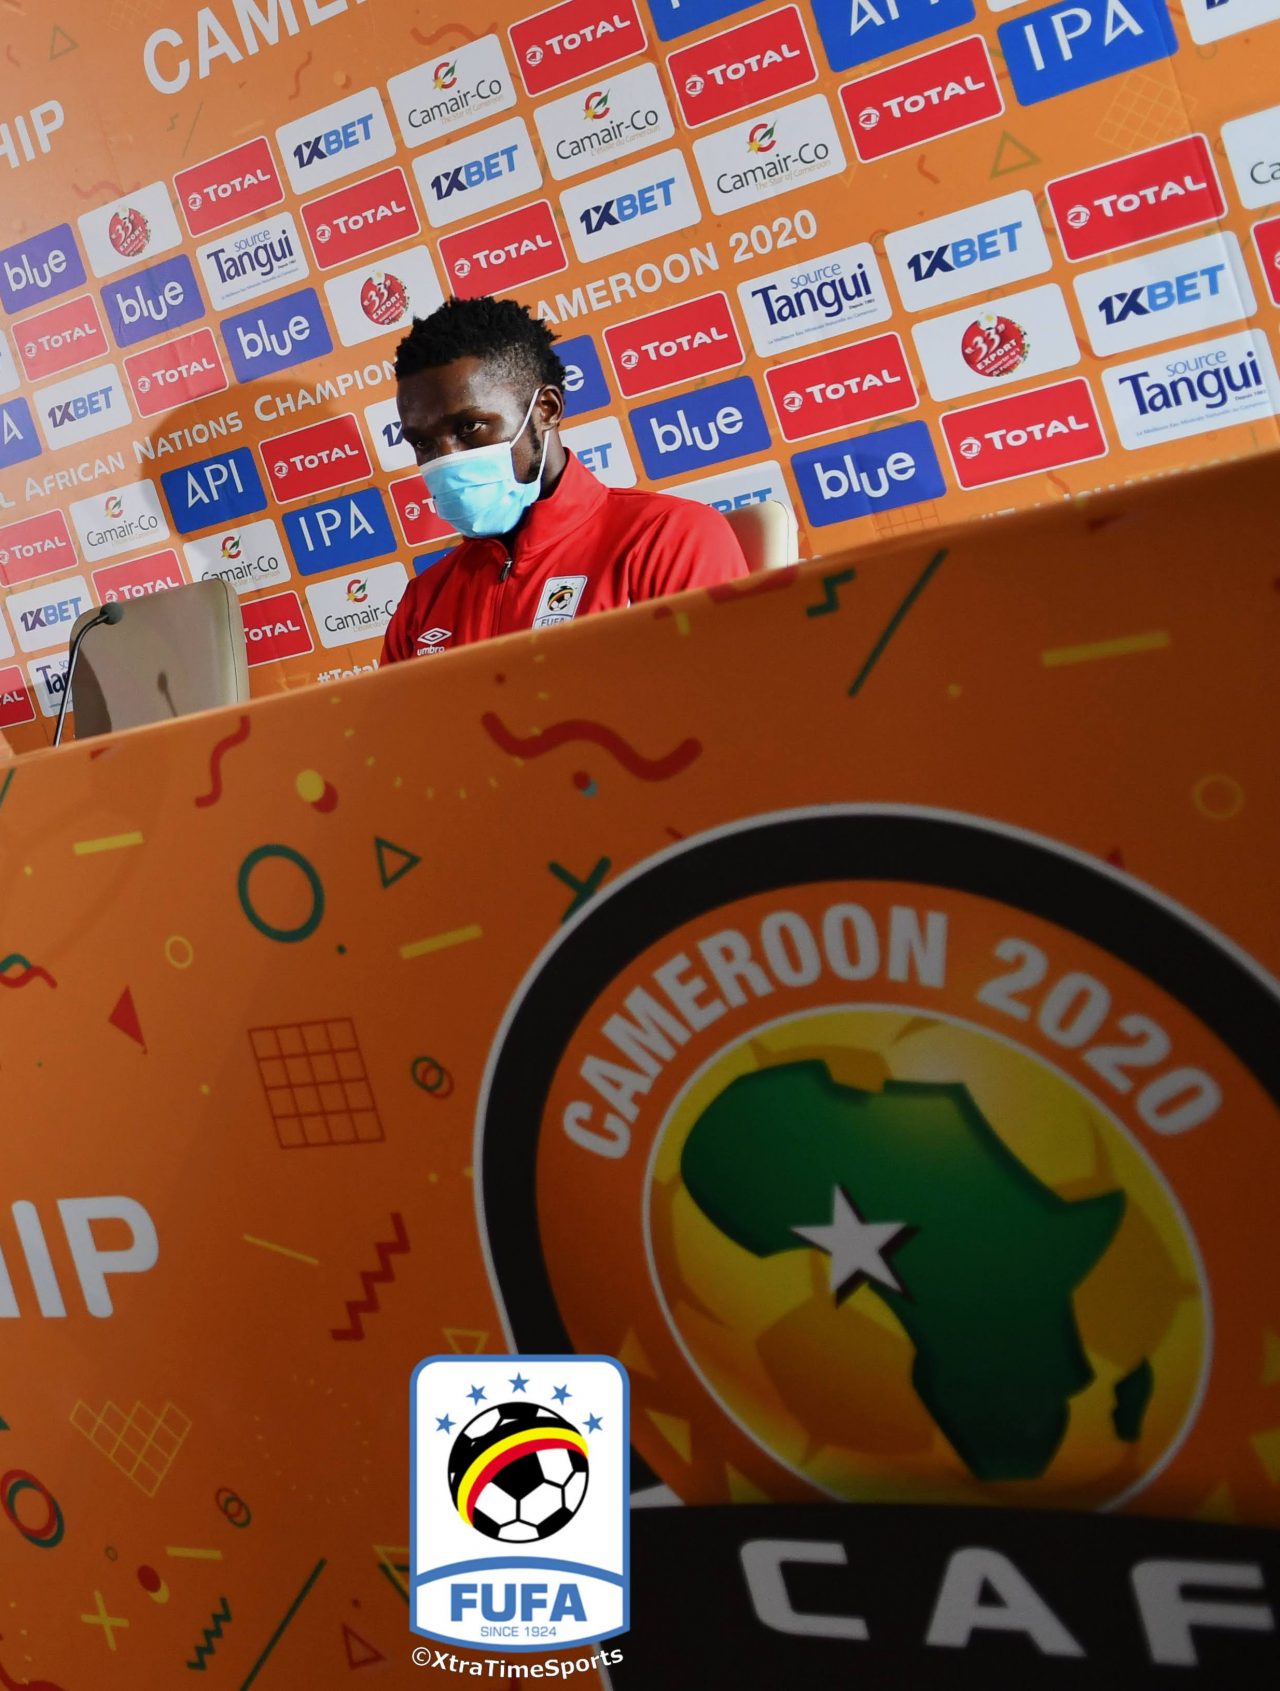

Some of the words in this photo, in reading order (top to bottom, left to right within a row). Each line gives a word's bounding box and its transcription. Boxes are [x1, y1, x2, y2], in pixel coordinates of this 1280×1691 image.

[546, 15, 630, 55] TOTAL
[1024, 0, 1145, 71] IPA
[707, 44, 800, 85] TOTAL
[408, 79, 502, 128] Camair-Co
[882, 76, 985, 118] TOTAL
[293, 113, 373, 169] 1XBET
[556, 110, 658, 159] Camair-Co
[204, 168, 271, 203] TOTAL
[431, 144, 519, 202] 1XBET
[717, 143, 828, 193] Camair-Co
[333, 200, 406, 235] TOTAL
[580, 178, 676, 234] 1XBET
[1094, 176, 1207, 217] TOTAL
[207, 229, 294, 283] Tangui
[234, 230, 271, 252] source
[472, 234, 552, 273] TOTAL
[907, 222, 1023, 282] 1XBET
[4, 250, 67, 292] blue
[536, 242, 720, 325] AMEROON
[729, 209, 818, 263] 2020
[790, 263, 841, 290] source
[116, 281, 184, 324] blue
[751, 262, 872, 325] Tangui
[1098, 263, 1225, 326] 1XBET
[38, 323, 96, 352] TOTAL
[237, 314, 310, 360] blue
[641, 326, 729, 362] TOTAL
[977, 339, 1017, 370] EXPORT
[152, 358, 216, 387] TOTAL
[1119, 351, 1263, 416] Tangui
[1166, 350, 1227, 378] source
[48, 386, 113, 428] 1XBET
[805, 369, 901, 404] TOTAL
[25, 452, 125, 501] AFRICAN
[132, 411, 243, 465] NATIONS
[254, 357, 398, 422] CHAMPION
[650, 406, 744, 454] blue
[984, 415, 1089, 450] TOTAL
[290, 443, 359, 473] TOTAL
[814, 452, 916, 500] blue
[186, 458, 245, 509] API
[86, 514, 158, 548] Camair-Co
[298, 499, 376, 552] IPA
[11, 536, 66, 560] TOTAL
[119, 576, 179, 600] TOTAL
[324, 599, 397, 632] Camair-C
[417, 645, 445, 656] umbro
[562, 901, 948, 1159] CAMEROON
[976, 937, 1222, 1136] 2020
[740, 1539, 1275, 1667] CAF
